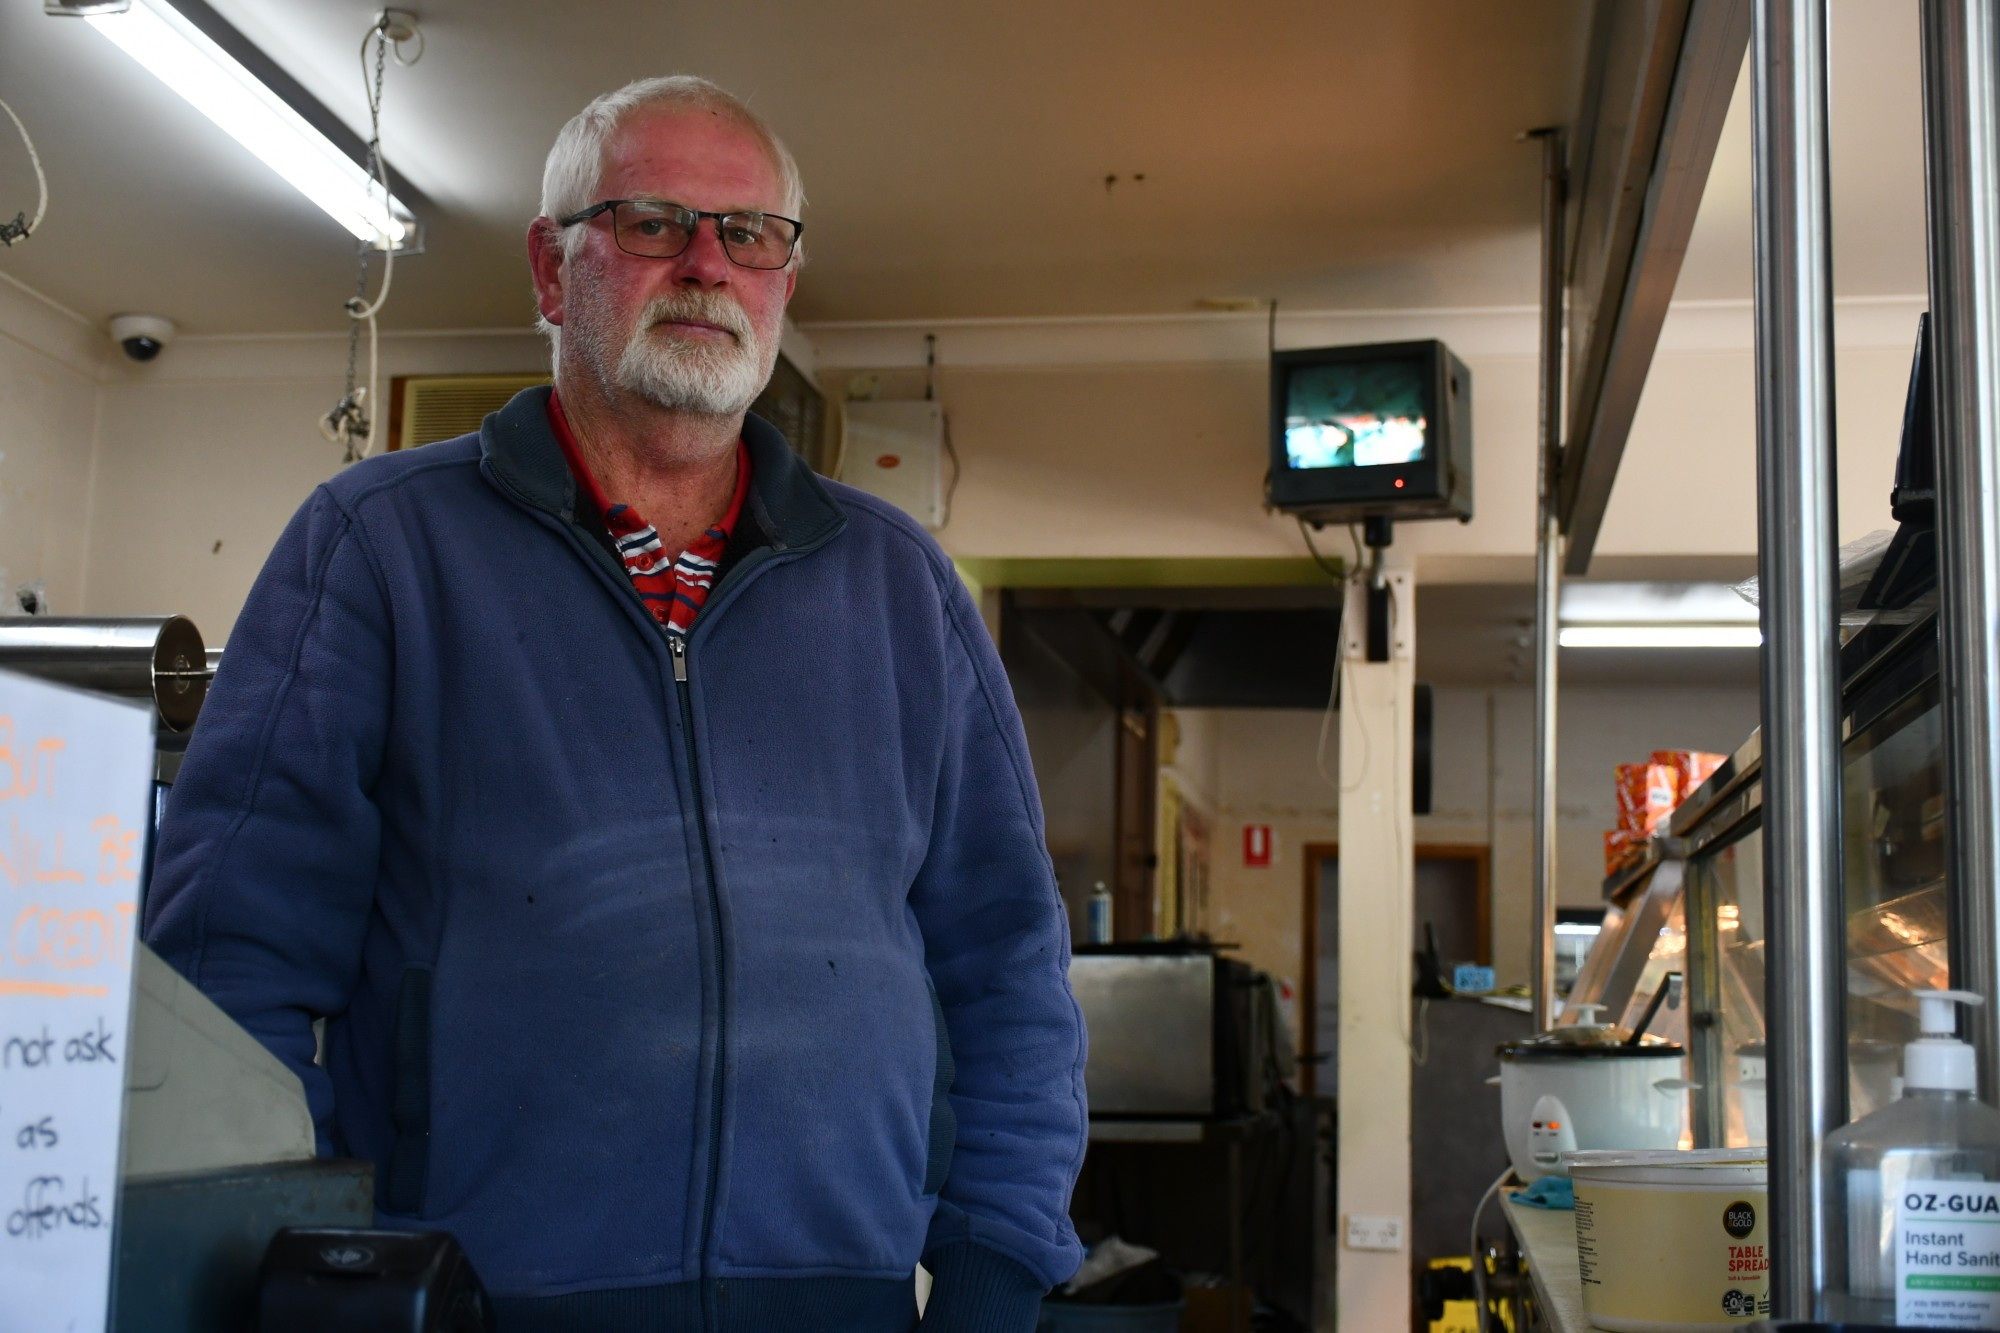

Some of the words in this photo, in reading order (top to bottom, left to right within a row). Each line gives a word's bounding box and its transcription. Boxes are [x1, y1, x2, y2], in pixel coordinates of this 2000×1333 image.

[91, 814, 139, 885] BE
[10, 902, 139, 972] CREDIT
[4, 1024, 55, 1068] not
[64, 1016, 116, 1064] ask
[16, 1116, 58, 1149] as
[1728, 1211, 1752, 1220] BLACK
[1905, 1231, 1965, 1246] Instant
[1728, 1245, 1764, 1259] TABLE
[1905, 1251, 1951, 1266] Hand
[1728, 1258, 1770, 1272] SPREAD
